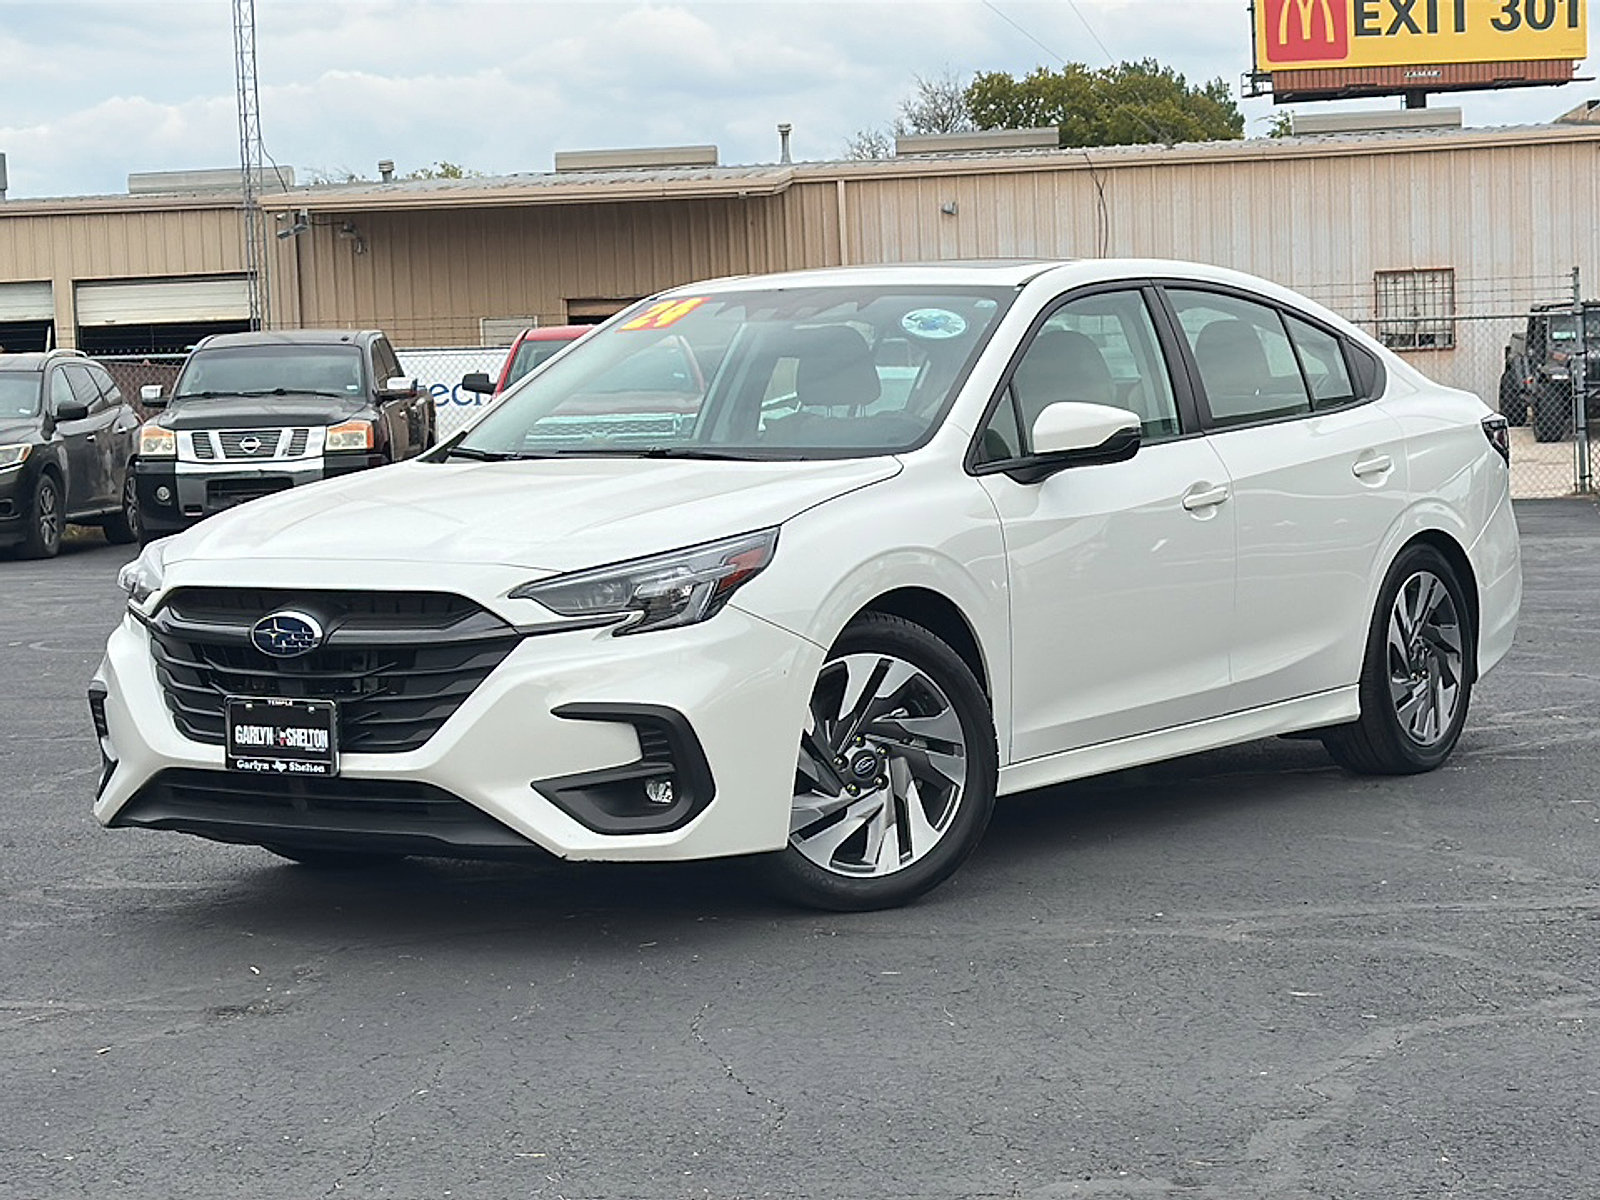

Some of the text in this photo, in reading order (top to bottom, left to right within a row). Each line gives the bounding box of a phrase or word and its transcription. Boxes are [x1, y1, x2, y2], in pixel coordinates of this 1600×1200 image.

[1354, 0, 1579, 37] EXIT 301
[235, 725, 328, 748] GARLYN SHELTON
[236, 760, 269, 771] Garlyn
